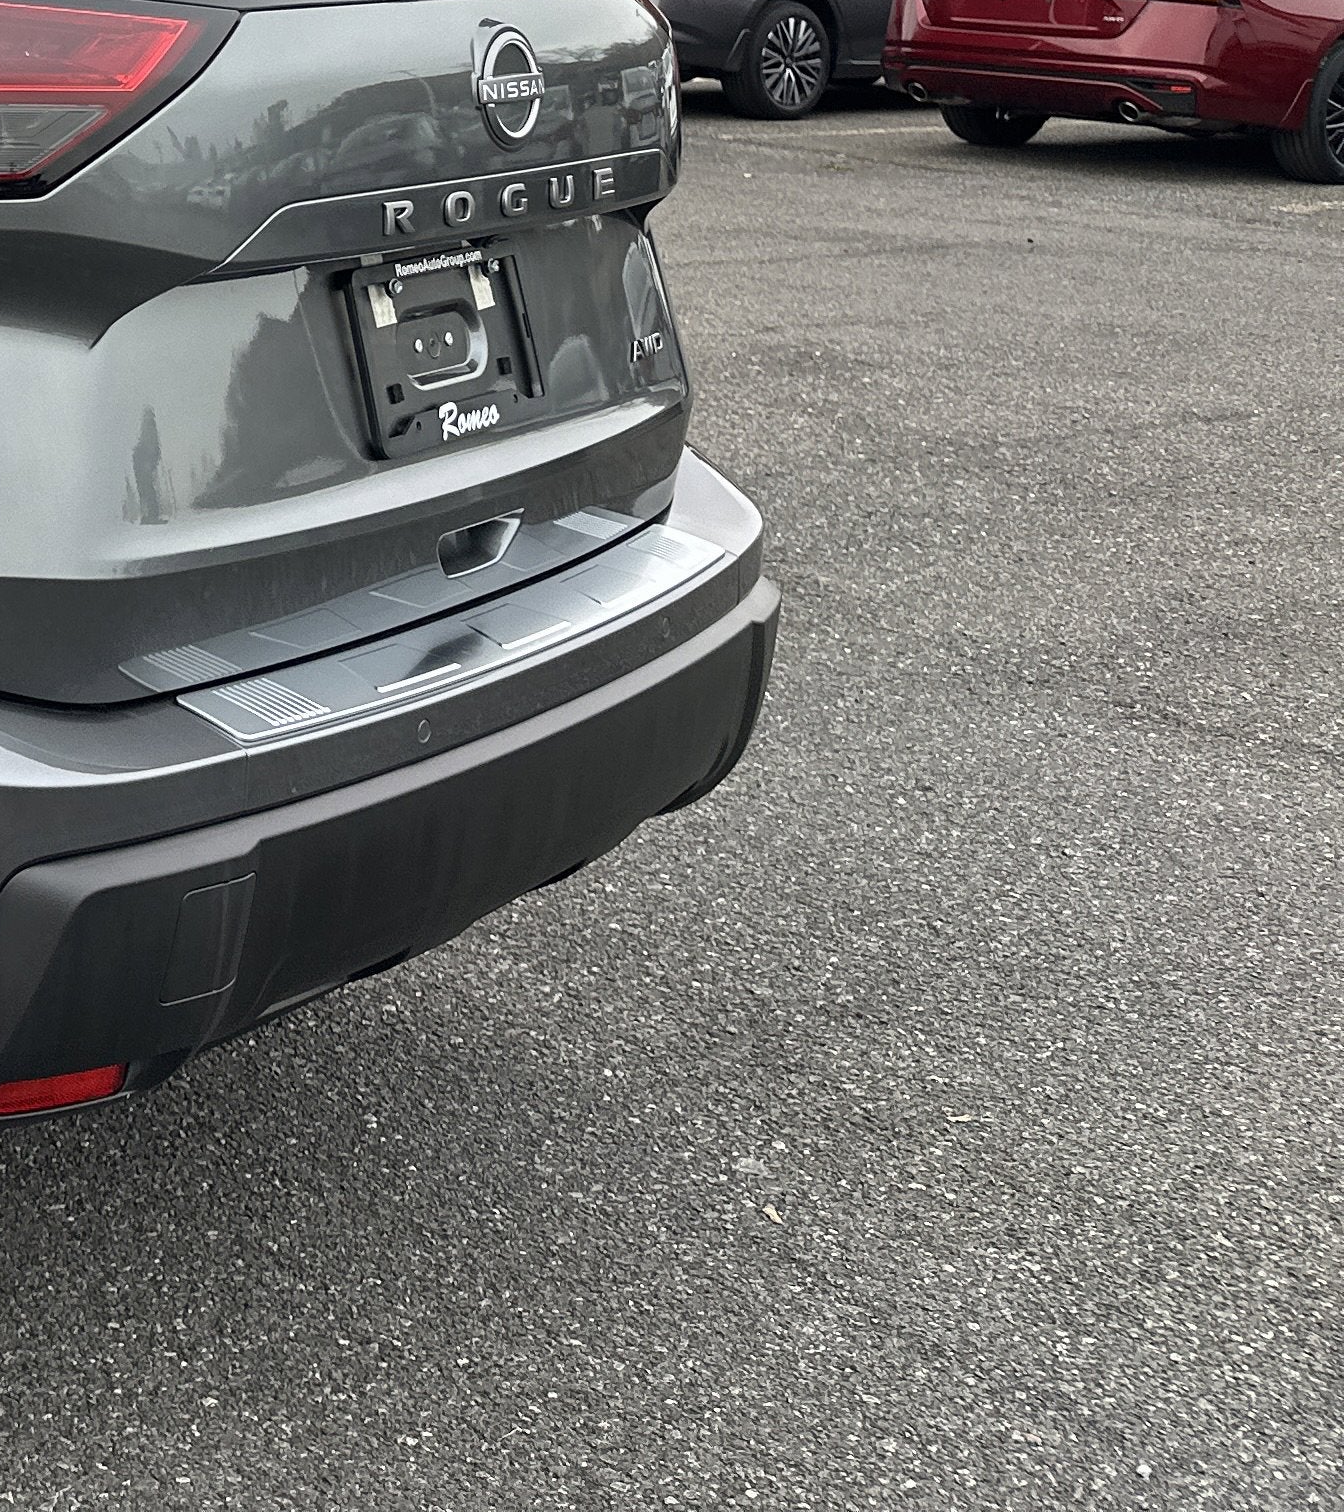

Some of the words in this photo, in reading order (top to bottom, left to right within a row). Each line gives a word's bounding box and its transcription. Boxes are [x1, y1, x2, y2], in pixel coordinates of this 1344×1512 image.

[482, 79, 545, 101] NISSAN
[382, 166, 617, 236] ROGUE
[394, 250, 482, 278] RomeoAutoGroup.com
[438, 401, 501, 440] Romeo
